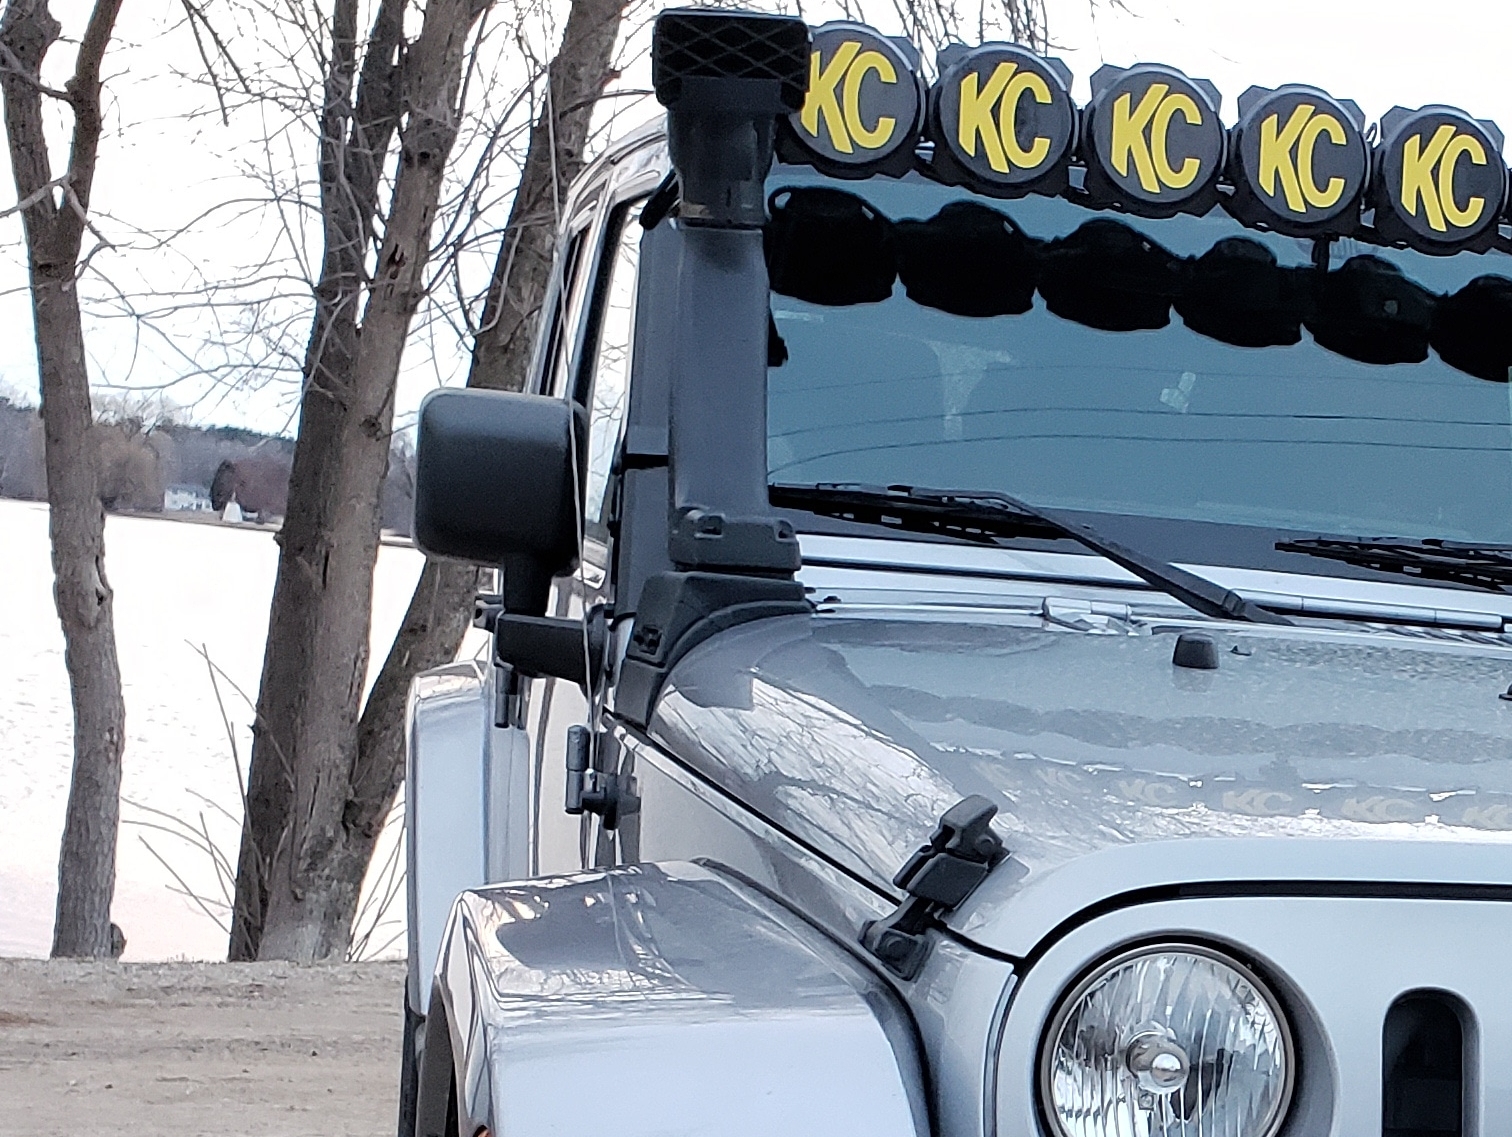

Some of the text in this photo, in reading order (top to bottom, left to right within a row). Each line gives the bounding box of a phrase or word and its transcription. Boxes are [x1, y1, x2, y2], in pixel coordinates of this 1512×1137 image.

[800, 41, 897, 154] KC
[959, 62, 1052, 174] KC
[1112, 84, 1201, 194] KC
[1259, 105, 1345, 213] KC
[1401, 125, 1486, 232] KC
